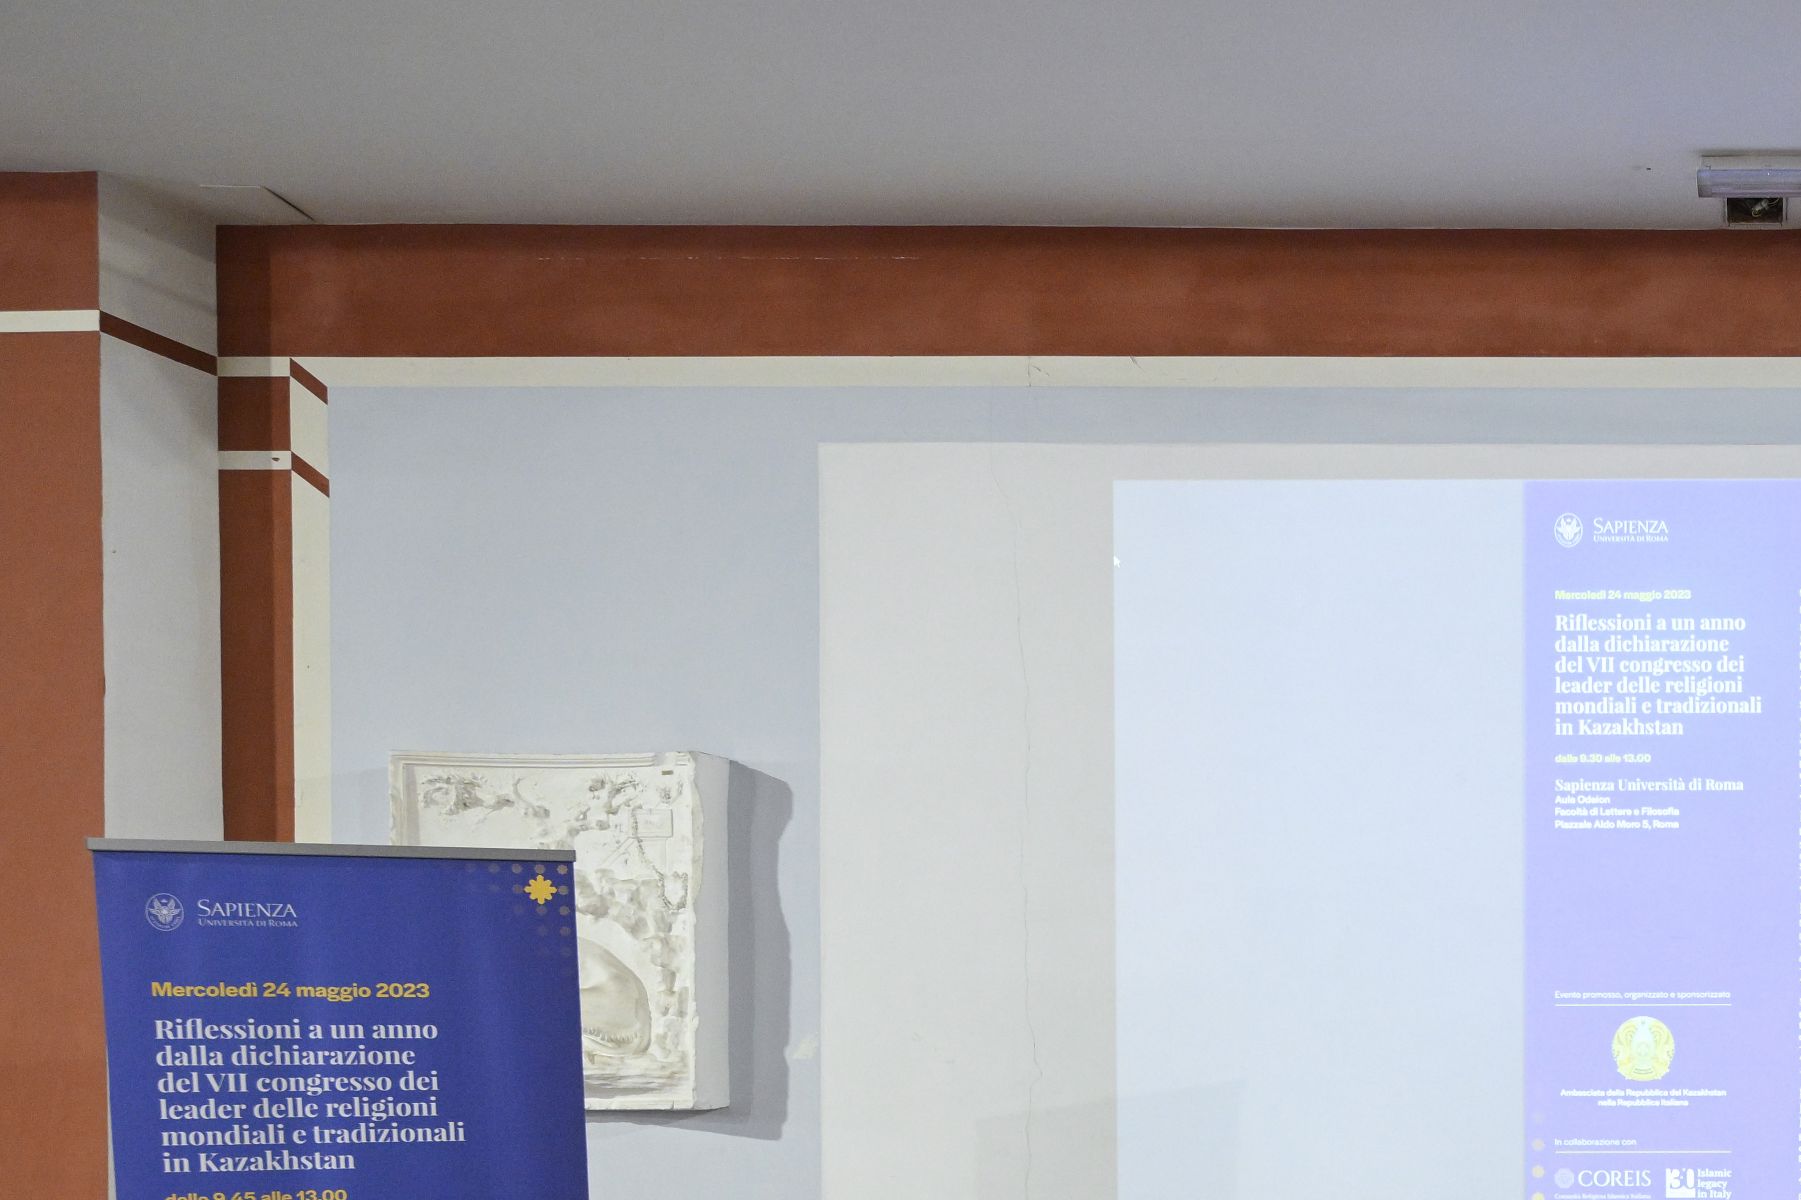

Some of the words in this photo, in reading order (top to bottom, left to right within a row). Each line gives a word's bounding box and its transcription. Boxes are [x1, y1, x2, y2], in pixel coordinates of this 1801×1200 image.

[1556, 614, 1652, 631] Riflessioni
[1657, 618, 1667, 630] a
[1672, 618, 1695, 631] un
[1700, 618, 1746, 631] anno
[1555, 635, 1600, 653] dalla
[1604, 635, 1729, 652] dichiarazione
[1555, 656, 1583, 673] del
[1586, 656, 1614, 673] VII
[1620, 658, 1712, 676] congresso
[1717, 655, 1744, 673] dei
[1556, 676, 1613, 694] leader
[1617, 676, 1660, 694] delle
[1666, 676, 1742, 696] religioni
[1556, 697, 1637, 714] mondiali
[1642, 701, 1652, 714] e
[1656, 696, 1761, 714] tradizionali
[1556, 718, 1573, 735] in
[1579, 718, 1683, 735] Kazakhstan
[152, 982, 258, 997] Mercoledì
[263, 982, 291, 997] 24
[296, 983, 371, 1002] maggio
[376, 983, 430, 998] 2023
[155, 1018, 302, 1040] Riflessioni
[309, 1025, 323, 1039] a
[330, 1025, 365, 1039] un
[373, 1025, 438, 1039] anno
[156, 1045, 224, 1066] dalla
[232, 1045, 415, 1066] dichiarazione
[158, 1072, 200, 1093] del
[205, 1074, 248, 1092] VII
[256, 1074, 392, 1096] congresso
[400, 1071, 439, 1091] dei
[160, 1098, 247, 1120] leader
[254, 1098, 318, 1118] delle
[326, 1096, 437, 1121] religioni
[162, 1124, 285, 1146] mondiali
[293, 1130, 306, 1144] e
[314, 1122, 466, 1144] tradizionali
[163, 1152, 191, 1173] in
[199, 1150, 355, 1172] Kazakhstan
[1578, 1170, 1651, 1187] COREIS
